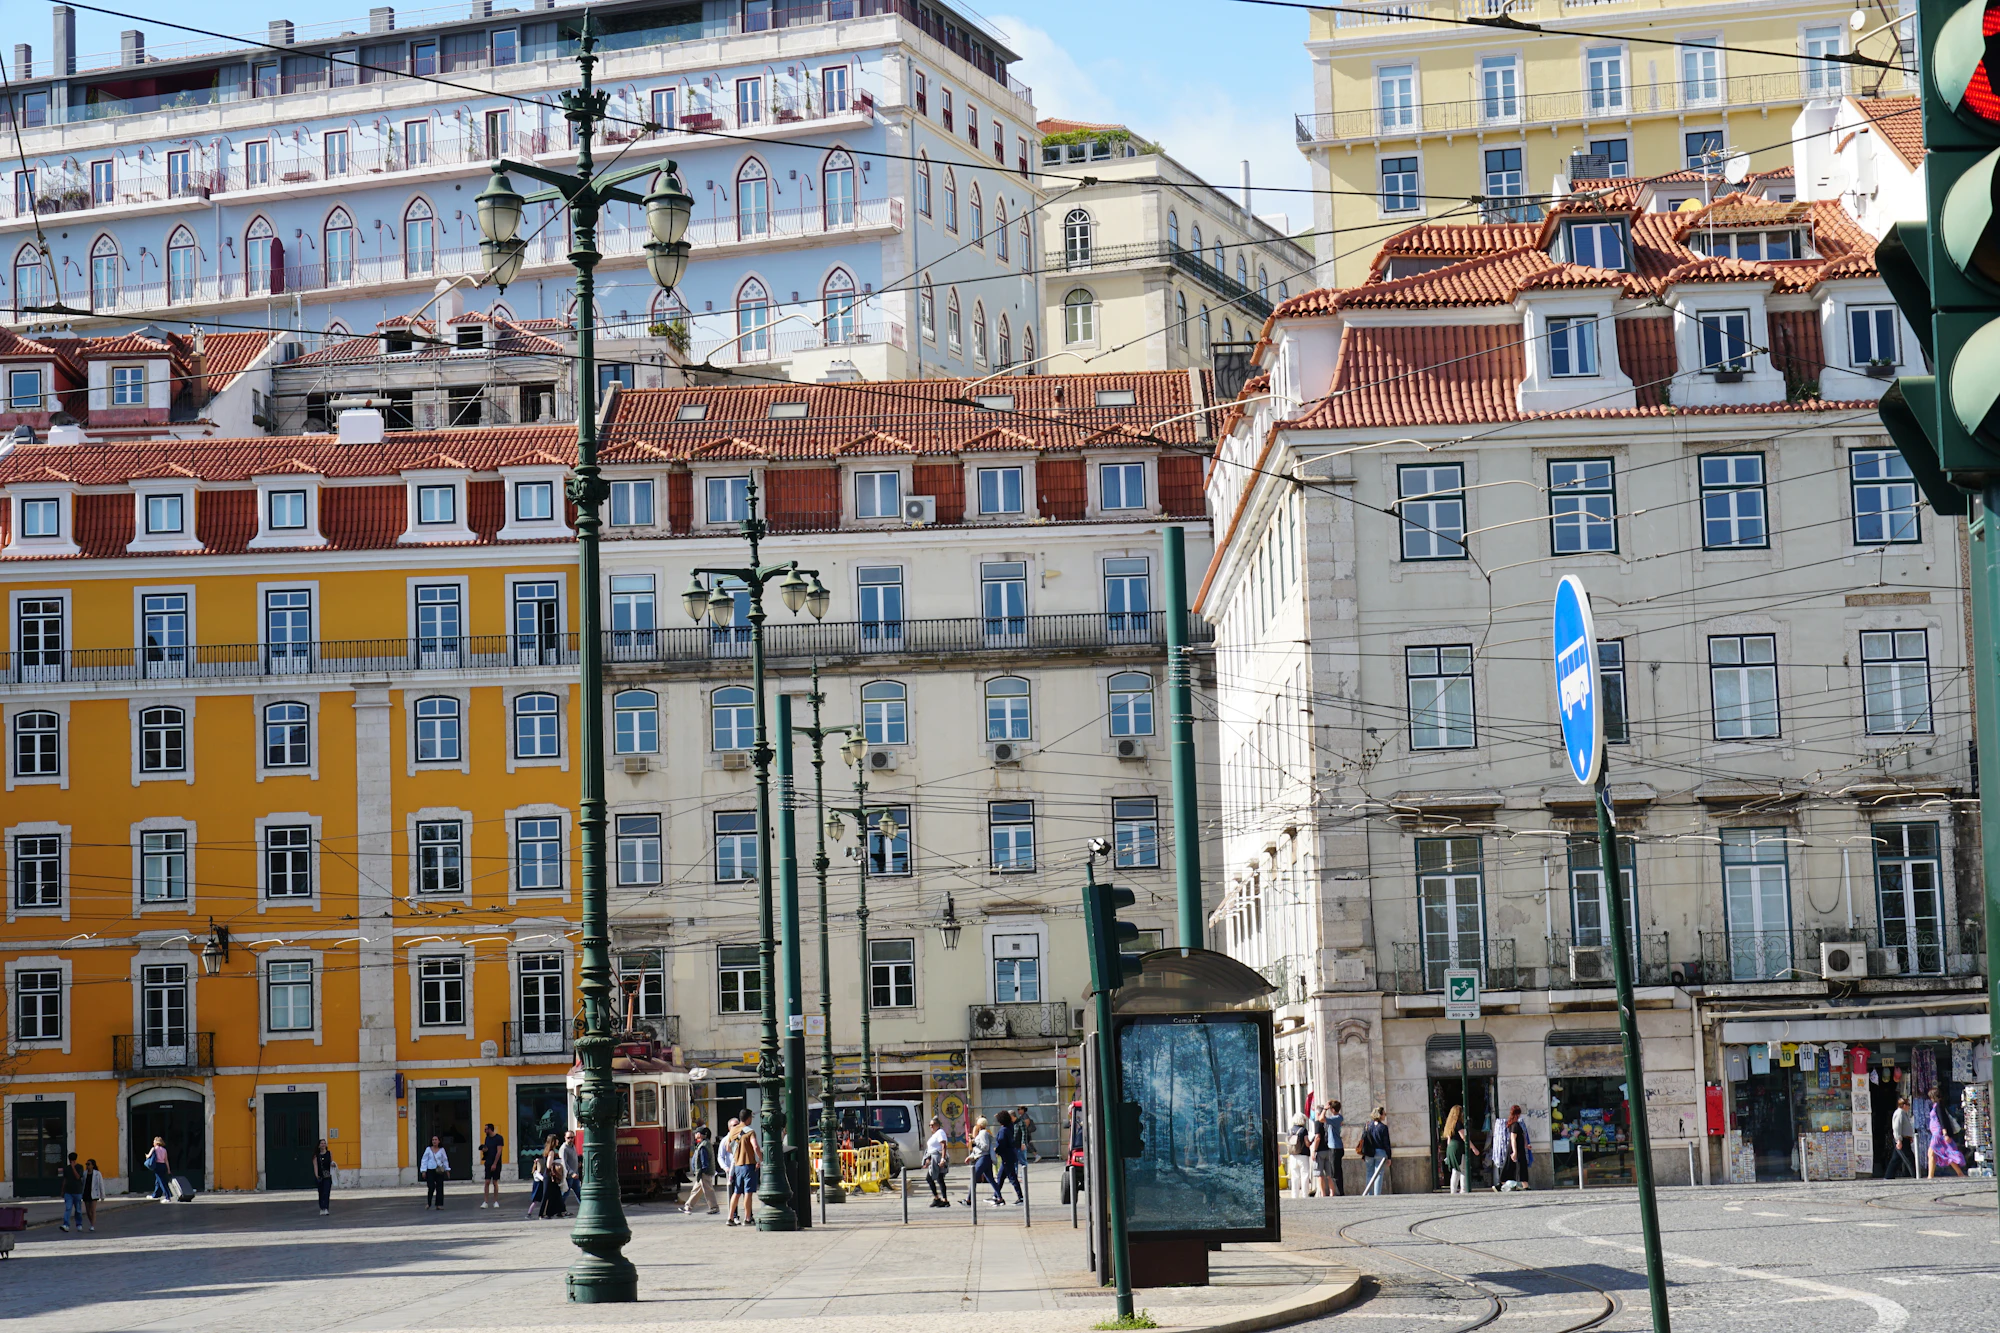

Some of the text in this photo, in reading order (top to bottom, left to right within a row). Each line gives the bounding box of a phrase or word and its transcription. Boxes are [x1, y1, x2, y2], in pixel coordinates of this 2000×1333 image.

[1782, 1052, 1791, 1061] 10
[1803, 1051, 1811, 1060] 10
[1834, 1049, 1839, 1058] 7
[1858, 1054, 1863, 1064] 7
